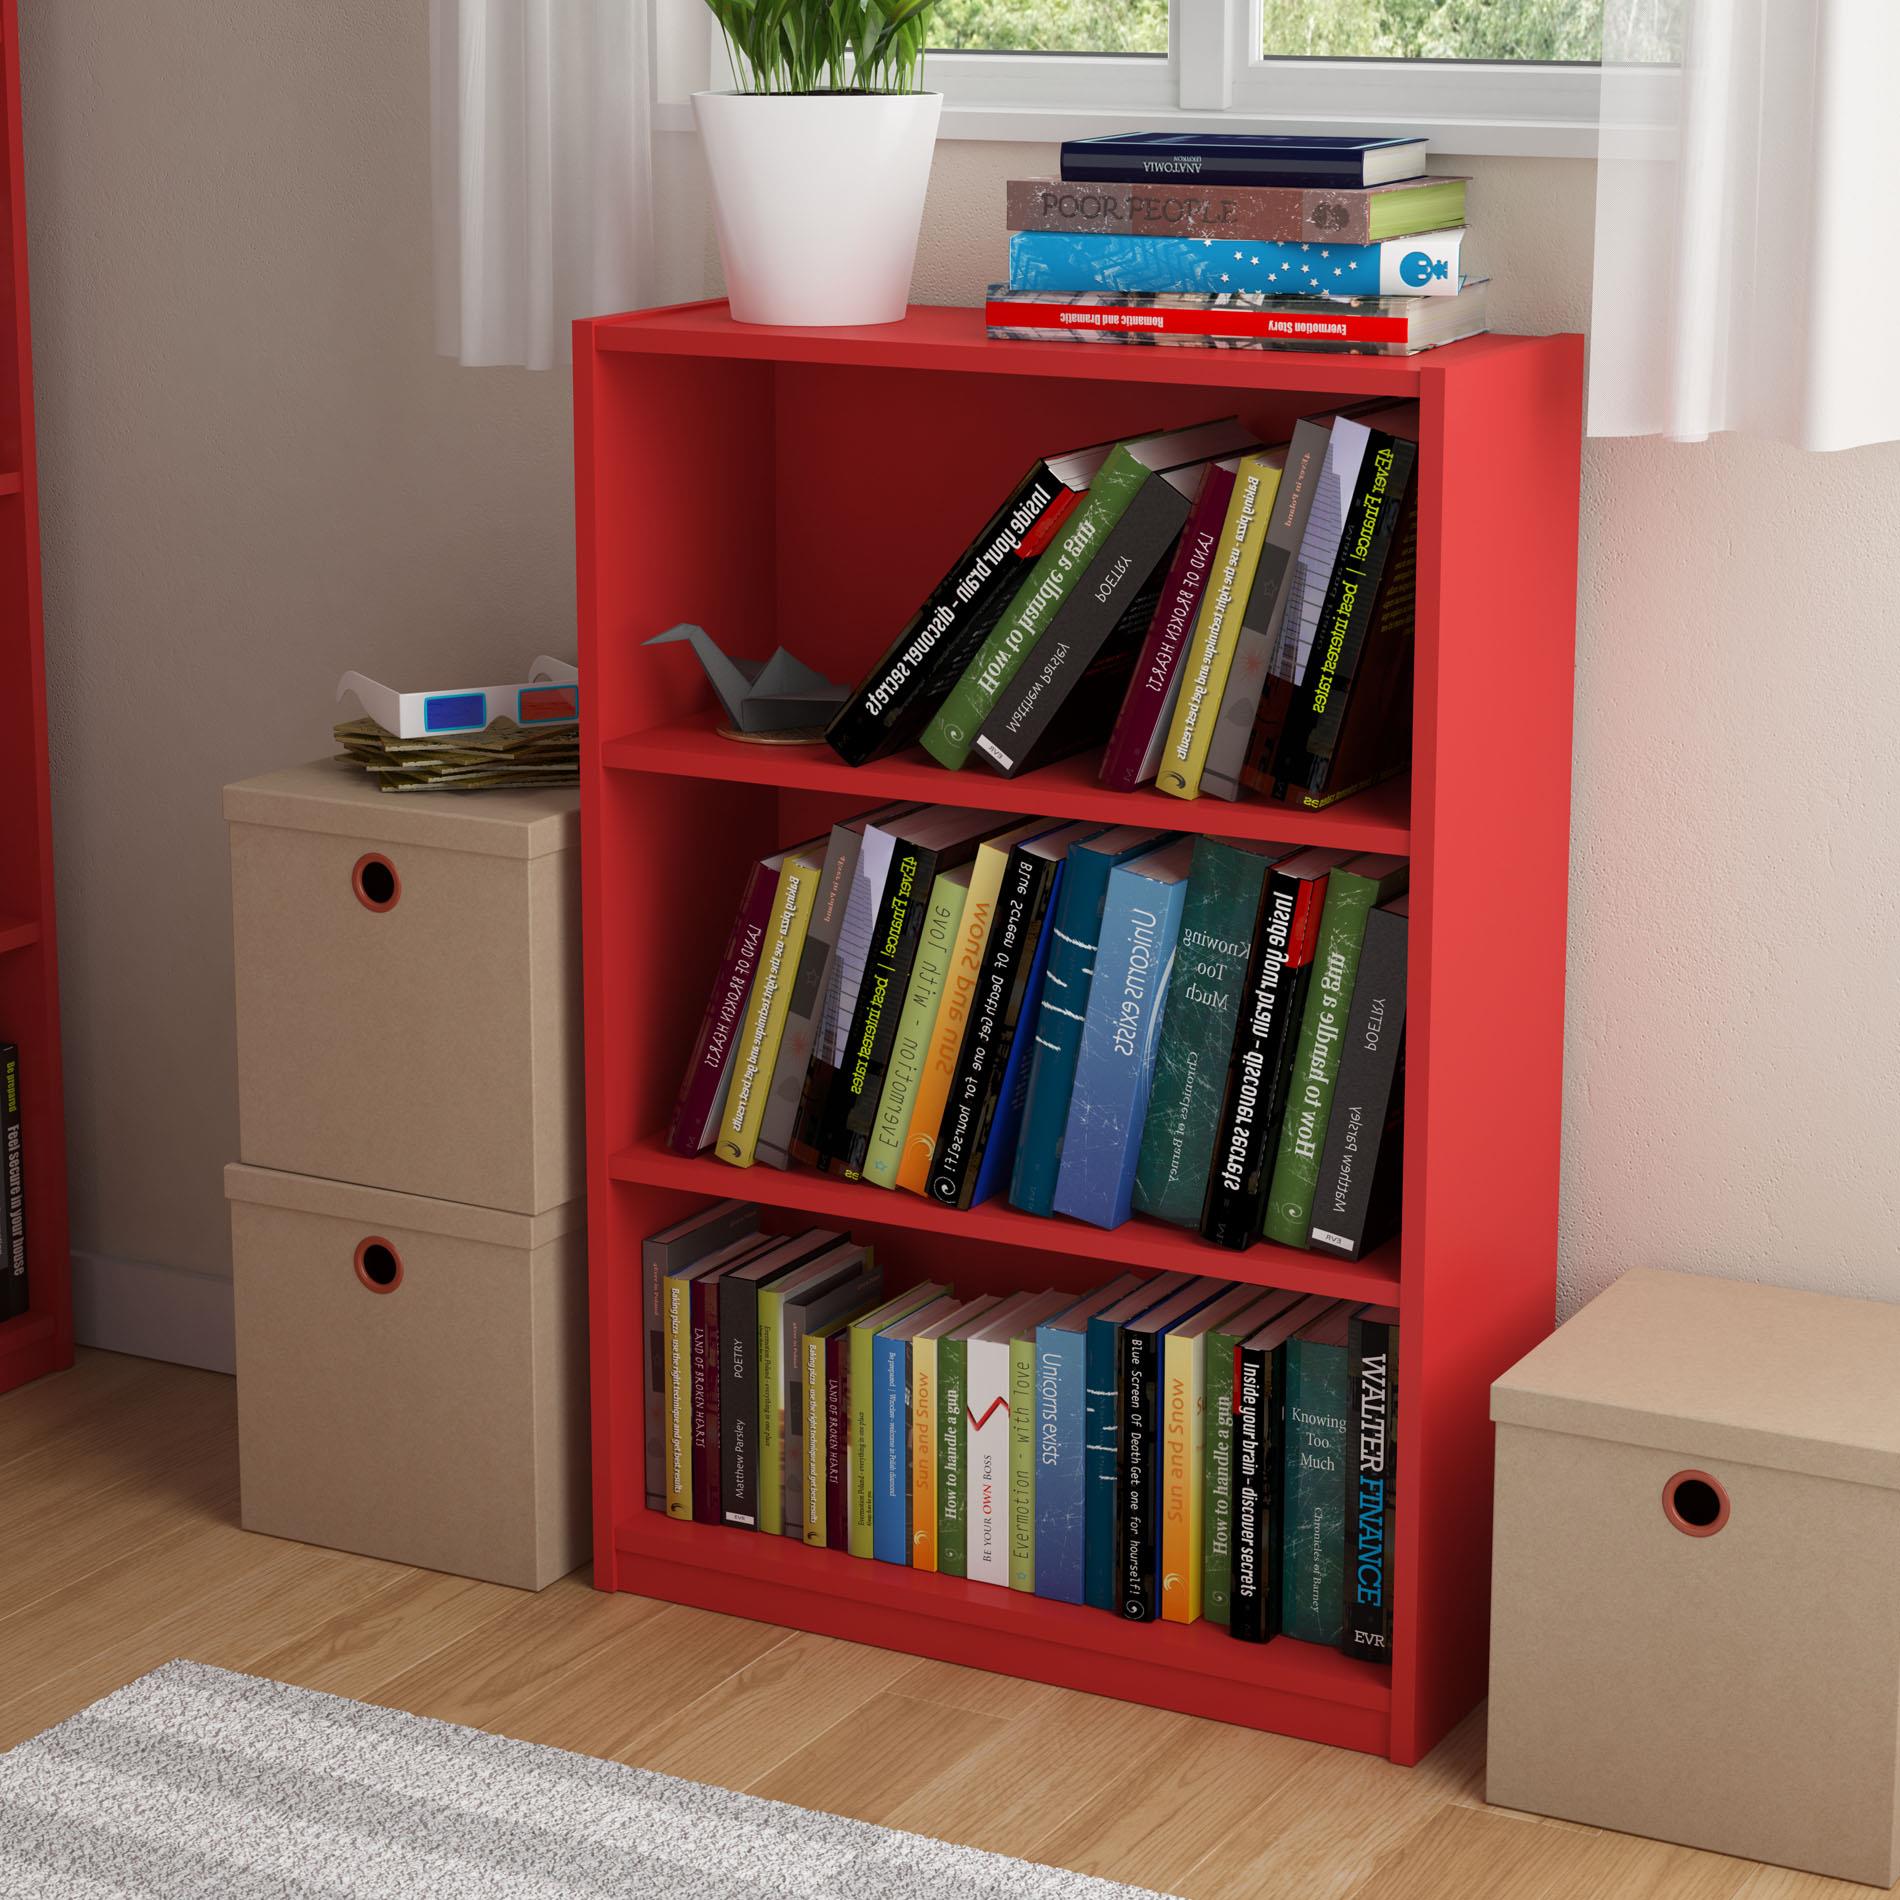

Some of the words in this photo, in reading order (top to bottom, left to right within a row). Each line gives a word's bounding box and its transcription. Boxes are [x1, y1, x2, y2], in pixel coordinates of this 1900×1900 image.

[1143, 161, 1202, 173] ANATOMIA
[1040, 192, 1123, 220] POOR
[1126, 197, 1237, 224] PEOPLE
[1060, 312, 1100, 325] Dramatic
[1102, 314, 1119, 325] and
[1120, 315, 1163, 328] Romantic
[1268, 320, 1293, 333] Story
[1294, 322, 1346, 335] Evermotion
[7, 1124, 20, 1152] Feel
[8, 1151, 20, 1194] secure
[10, 1208, 22, 1236] your
[12, 1237, 24, 1275] house
[670, 1288, 680, 1314] Baking
[670, 1314, 680, 1334] pizza
[694, 1327, 704, 1354] LAND
[1131, 1339, 1142, 1364] Blue
[695, 1356, 704, 1369] OF
[733, 1338, 743, 1378] POETRY
[671, 1366, 681, 1385] right
[695, 1371, 704, 1409] BROKEN
[1012, 1361, 1030, 1395] love
[1042, 1353, 1062, 1421] Unicorns
[1131, 1370, 1142, 1408] Screen
[1243, 1362, 1259, 1404] Inside
[672, 1386, 681, 1423] technique
[916, 1372, 928, 1418] Snow
[947, 1390, 960, 1415] gun
[1168, 1378, 1184, 1434] Snow
[947, 1416, 957, 1424] a
[1012, 1407, 1030, 1442] with
[1131, 1413, 1142, 1427] Of
[1218, 1396, 1233, 1426] gun
[1238, 1405, 1255, 1439] your
[1292, 1407, 1346, 1433] Knowing
[1360, 1353, 1386, 1472] WALTER
[672, 1438, 681, 1451] get
[673, 1423, 682, 1439] and
[695, 1411, 705, 1448] HEARTS
[734, 1419, 745, 1453] Parsley
[916, 1423, 928, 1454] and
[1042, 1423, 1062, 1465] exists
[1217, 1429, 1229, 1439] a
[1305, 1431, 1329, 1448] Too
[674, 1452, 682, 1468] best
[944, 1426, 957, 1471] handle
[1130, 1432, 1141, 1464] Death
[1168, 1440, 1183, 1479] and
[1242, 1439, 1258, 1475] brain
[1300, 1452, 1334, 1471] Much
[674, 1468, 683, 1493] results
[734, 1454, 744, 1499] Matthew
[916, 1459, 928, 1489] Sun
[946, 1473, 957, 1486] to
[982, 1455, 992, 1480] BOSS
[1130, 1466, 1141, 1485] Get
[1212, 1441, 1229, 1496] handle
[944, 1488, 957, 1519] How
[982, 1484, 992, 1514] OWN
[1130, 1490, 1139, 1510] one
[1168, 1485, 1183, 1522] Sun
[1214, 1499, 1228, 1514] to
[1012, 1470, 1029, 1559] Evermotion
[1130, 1516, 1141, 1535] for
[1241, 1487, 1258, 1546] discover
[983, 1518, 992, 1546] YOUR
[1212, 1517, 1227, 1555] How
[1313, 1507, 1323, 1561] Chronicles
[1357, 1475, 1383, 1606] FINANCE
[982, 1549, 991, 1562] BE
[1129, 1540, 1141, 1594] hourself!
[1313, 1563, 1321, 1576] of
[1240, 1546, 1256, 1597] secrets
[1310, 1577, 1321, 1613] Barney
[1354, 1629, 1385, 1647] EVR
